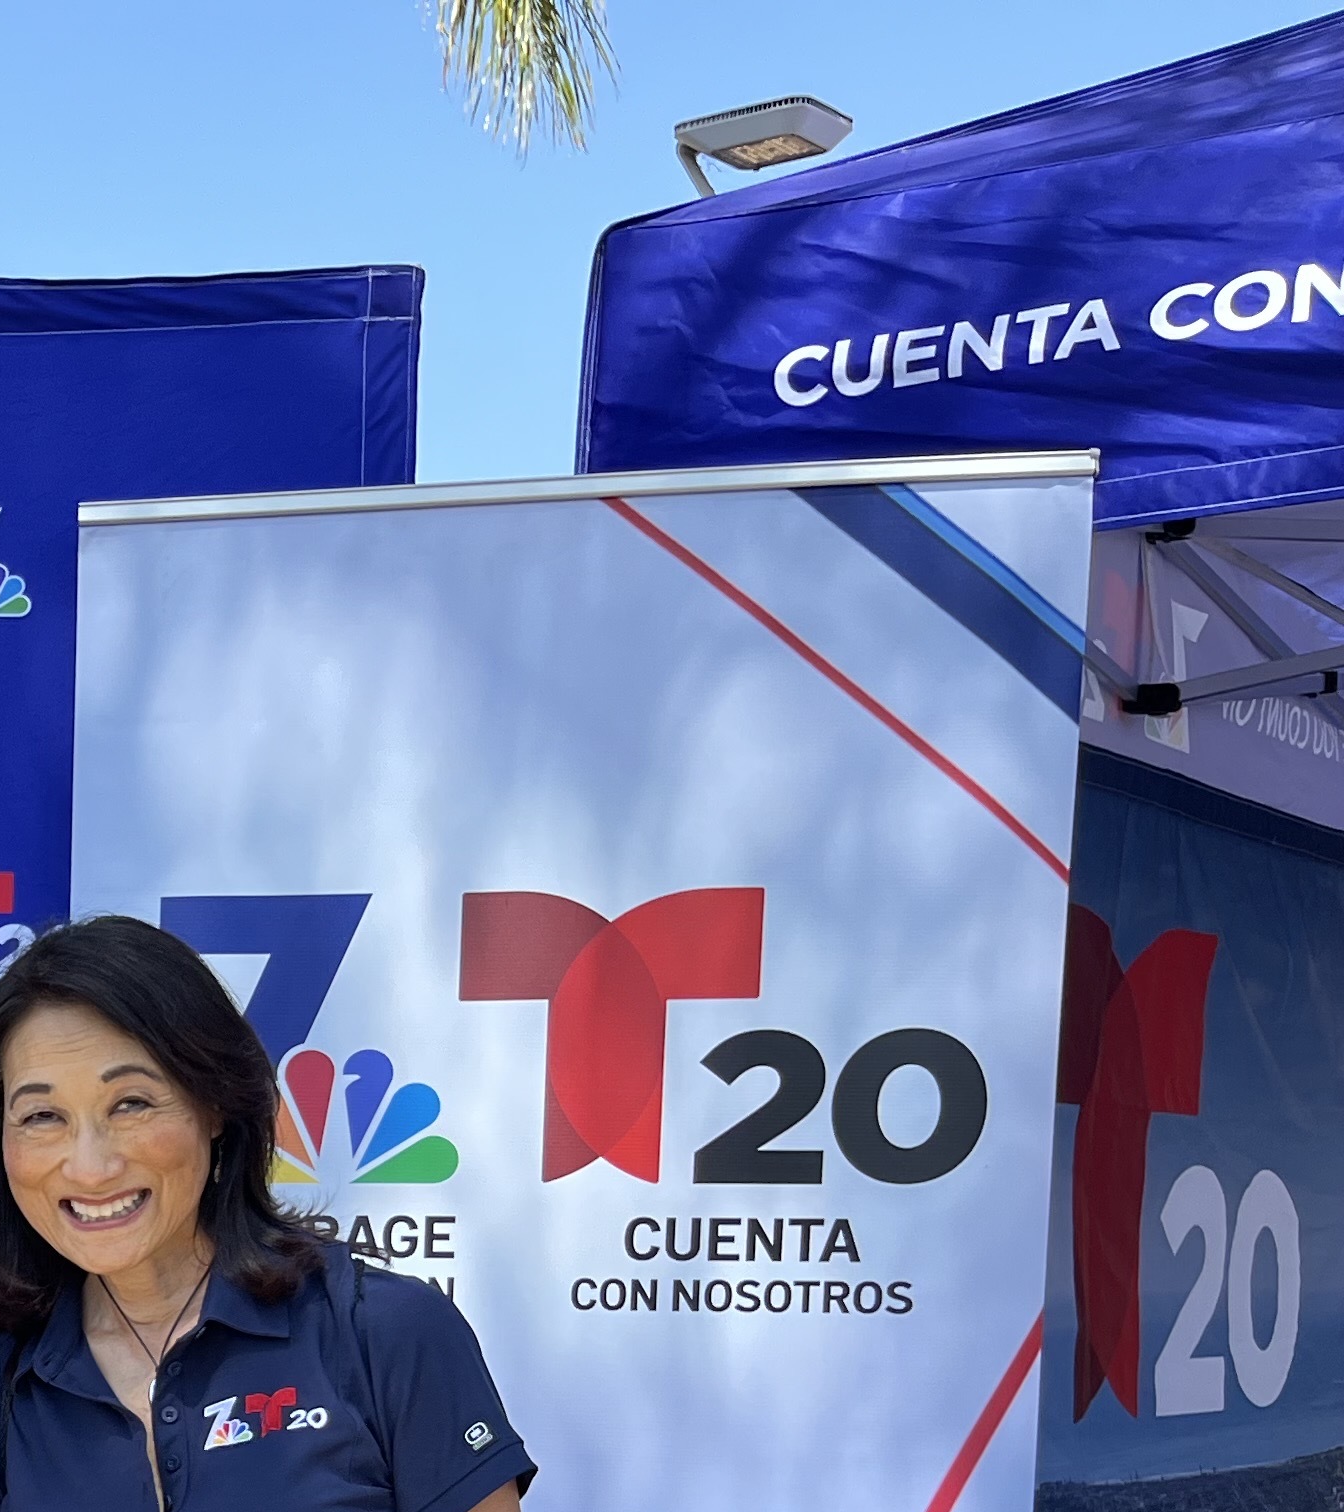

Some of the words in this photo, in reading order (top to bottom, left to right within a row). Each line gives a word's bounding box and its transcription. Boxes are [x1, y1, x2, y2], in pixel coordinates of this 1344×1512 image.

[773, 298, 1120, 408] CUENTA
[1148, 263, 1344, 341] CON
[623, 1216, 861, 1264] CUENTA
[570, 1276, 659, 1312] CON
[671, 1278, 914, 1315] NOSOTROS
[203, 1396, 238, 1451] 7
